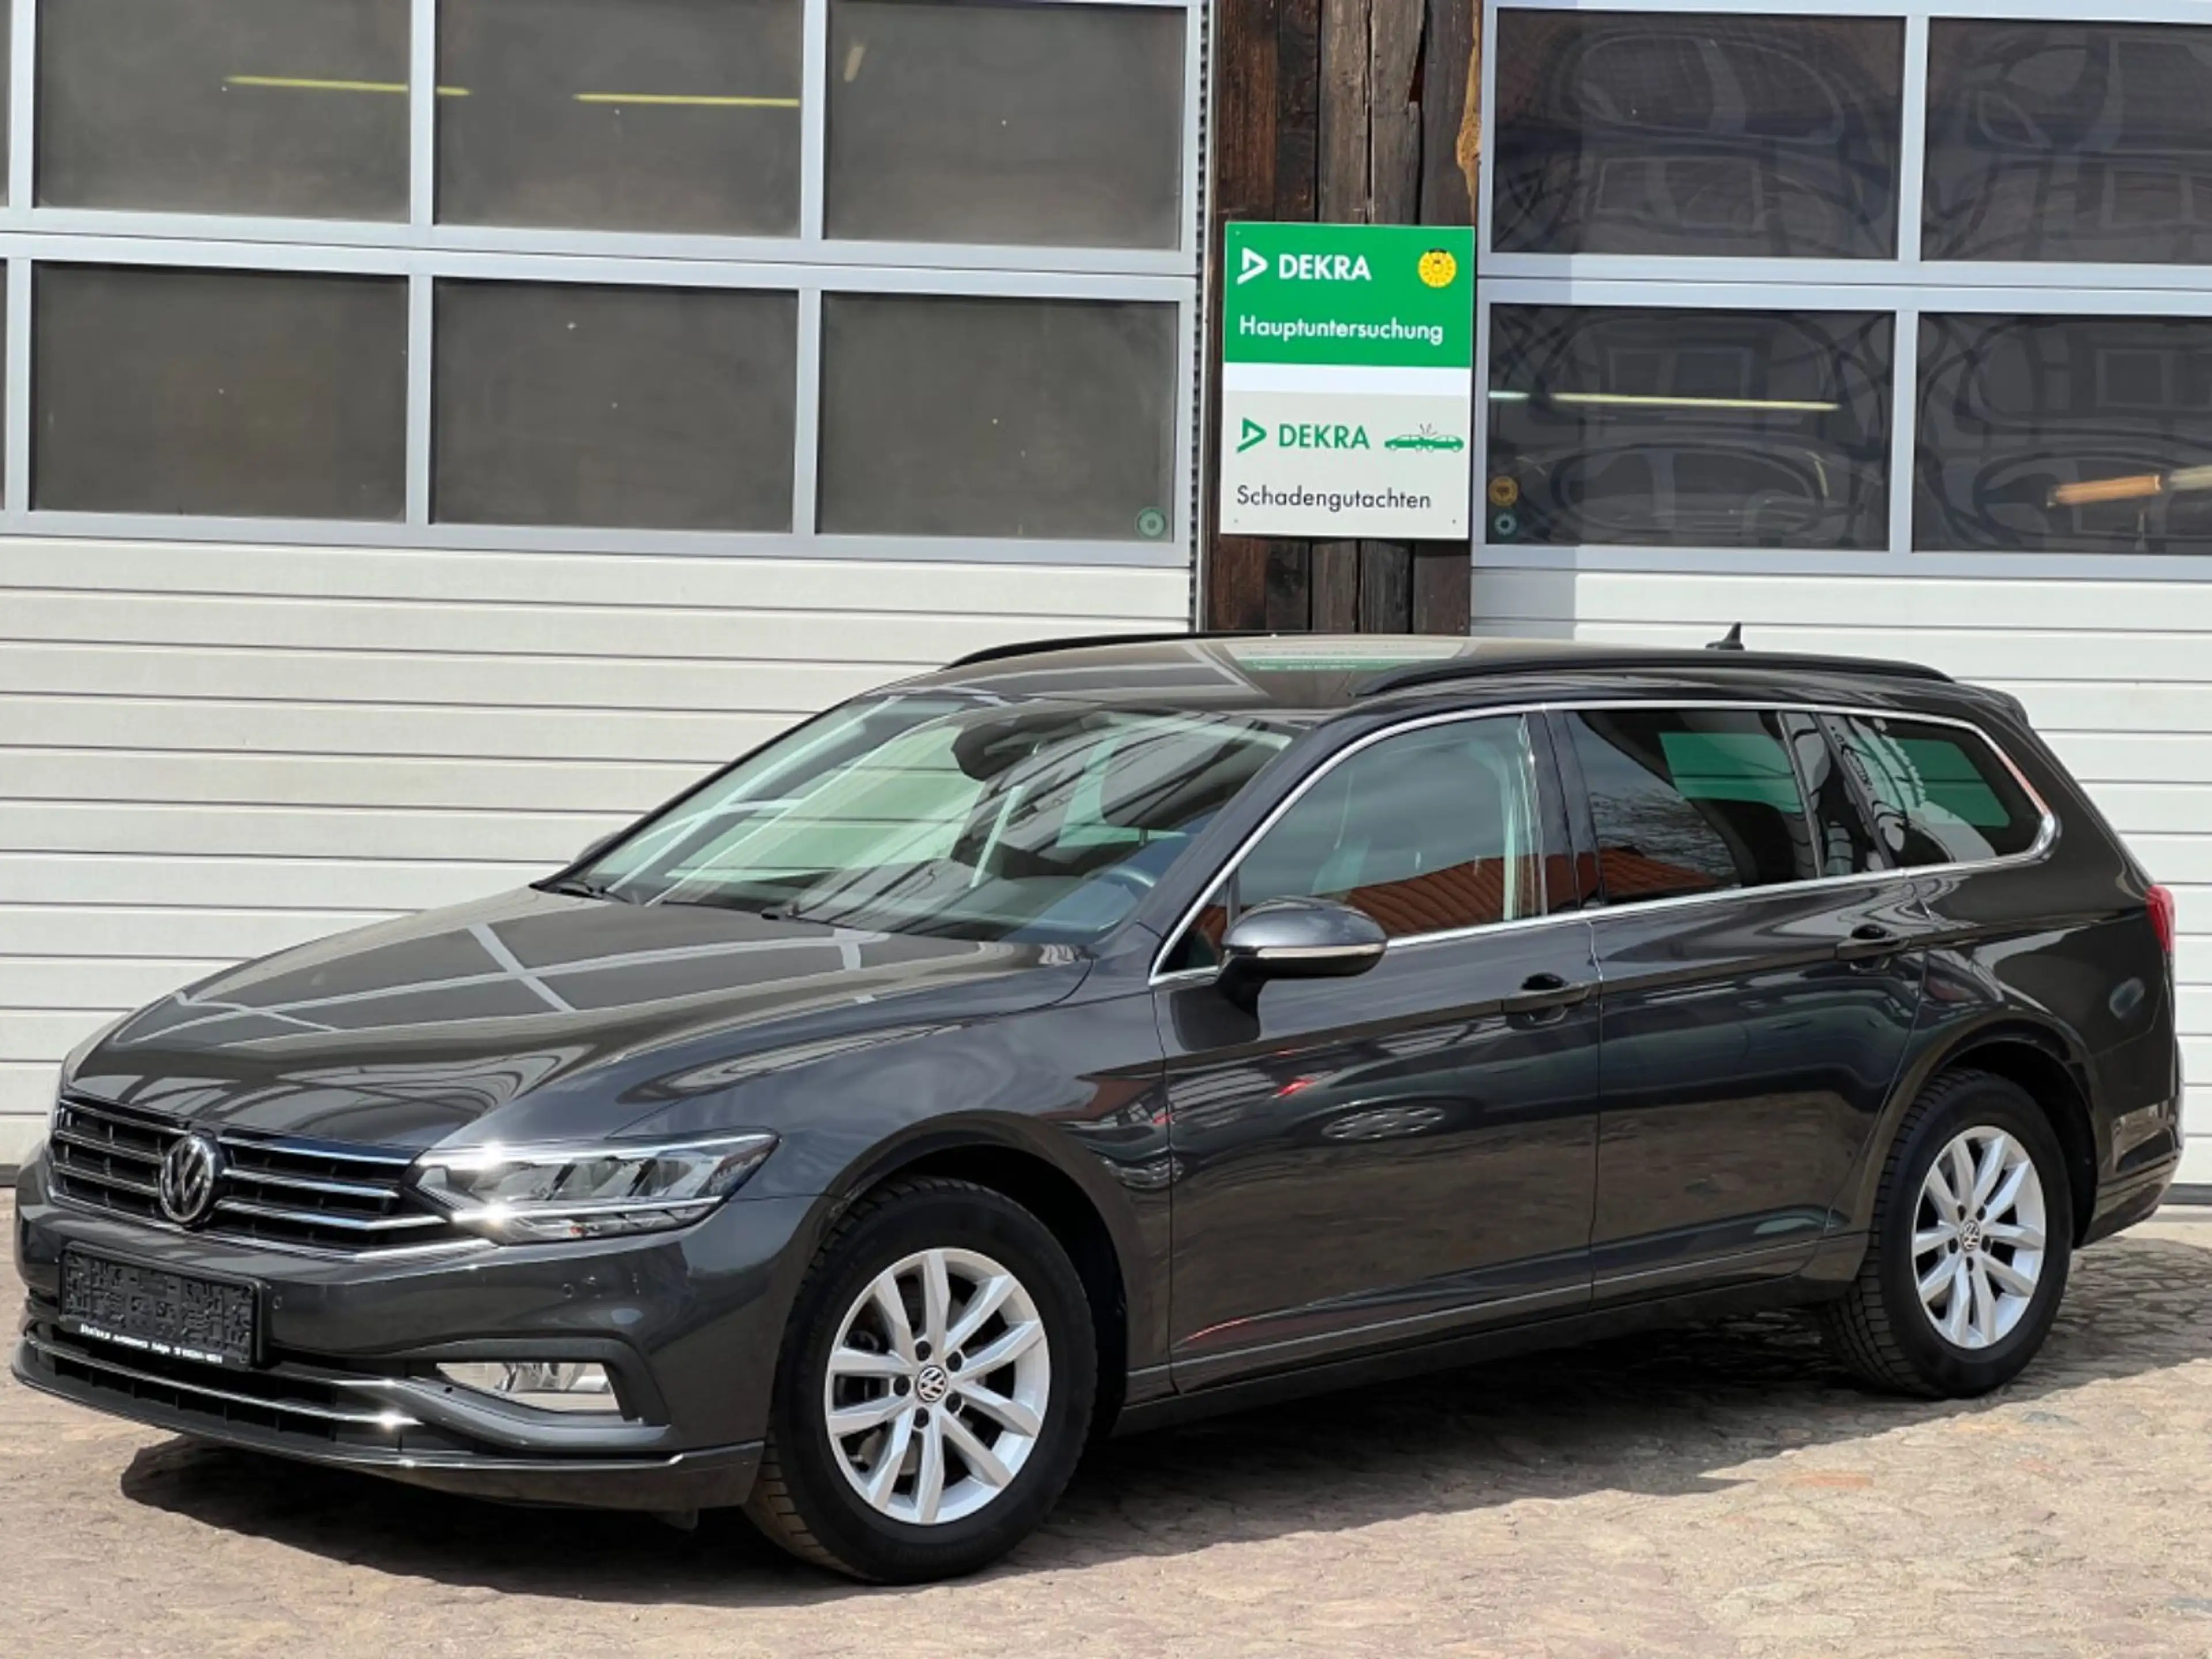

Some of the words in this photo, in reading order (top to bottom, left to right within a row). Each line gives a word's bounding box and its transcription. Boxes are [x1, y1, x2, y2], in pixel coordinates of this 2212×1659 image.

[1278, 253, 1372, 281] DEKRA
[1239, 315, 1444, 346] Hauptuntersuchung
[1278, 423, 1370, 449] DEKRA
[1237, 485, 1431, 512] Schadengutachten
